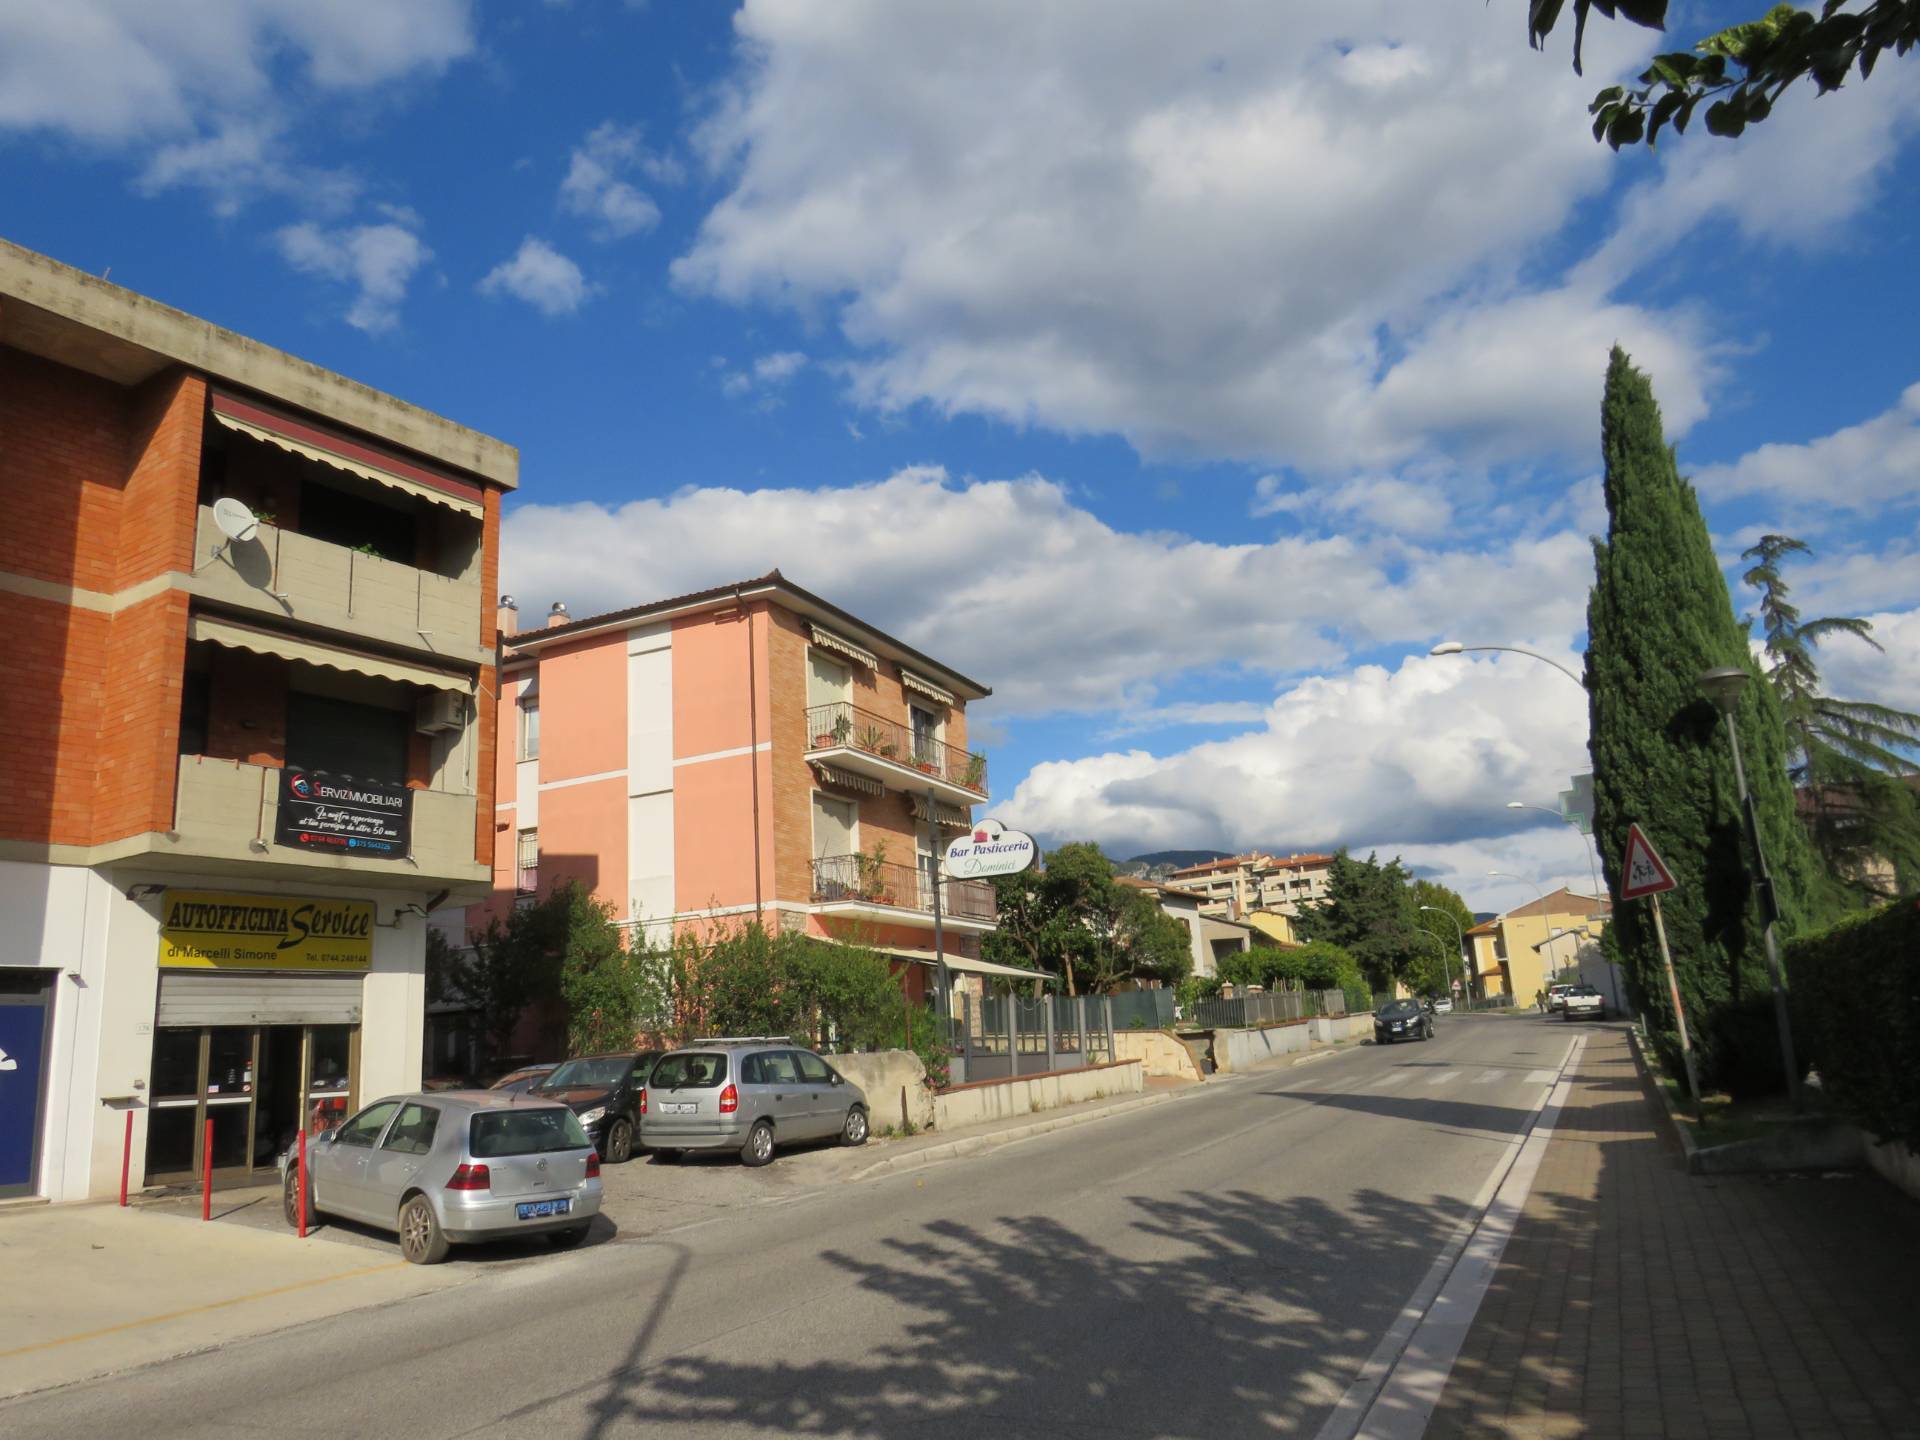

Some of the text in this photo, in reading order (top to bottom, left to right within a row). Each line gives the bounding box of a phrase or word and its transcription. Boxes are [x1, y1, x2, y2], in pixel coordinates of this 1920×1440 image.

[328, 811, 349, 823] nostra
[350, 815, 383, 825] esperienza
[319, 821, 345, 831] servizio
[355, 824, 371, 833] oltre
[372, 827, 383, 835] 50
[950, 840, 1029, 858] Bar Pasticceria
[964, 857, 1016, 875] Dominici
[167, 902, 369, 949] AUTOFFICINA Service
[167, 945, 277, 960] di Marcelli Simone
